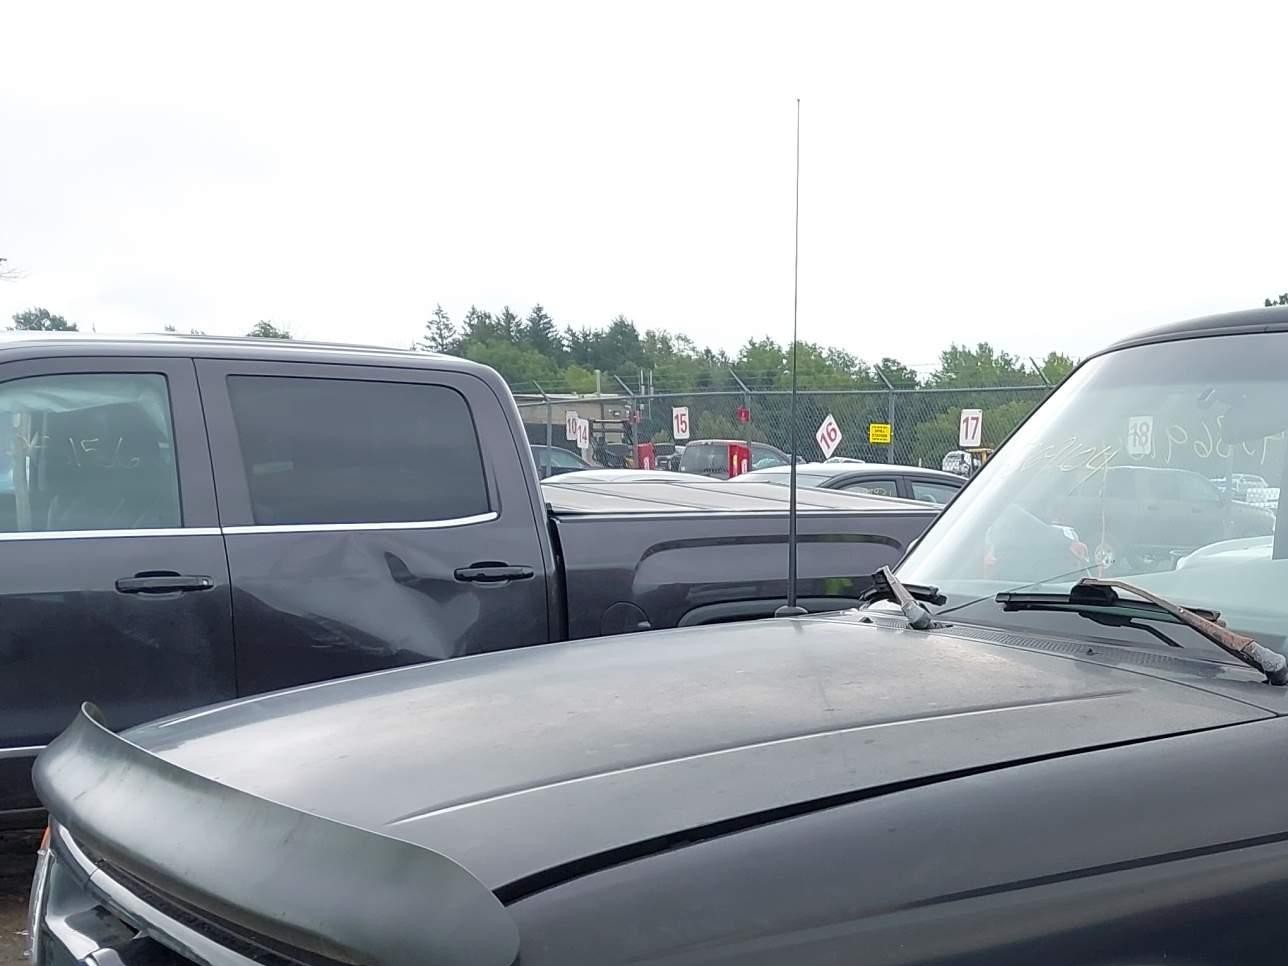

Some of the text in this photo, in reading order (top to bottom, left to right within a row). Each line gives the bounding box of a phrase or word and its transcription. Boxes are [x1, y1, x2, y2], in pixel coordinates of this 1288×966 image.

[577, 423, 588, 444] 14
[674, 413, 688, 435] 15
[819, 421, 838, 450] 16
[962, 416, 980, 441] 17
